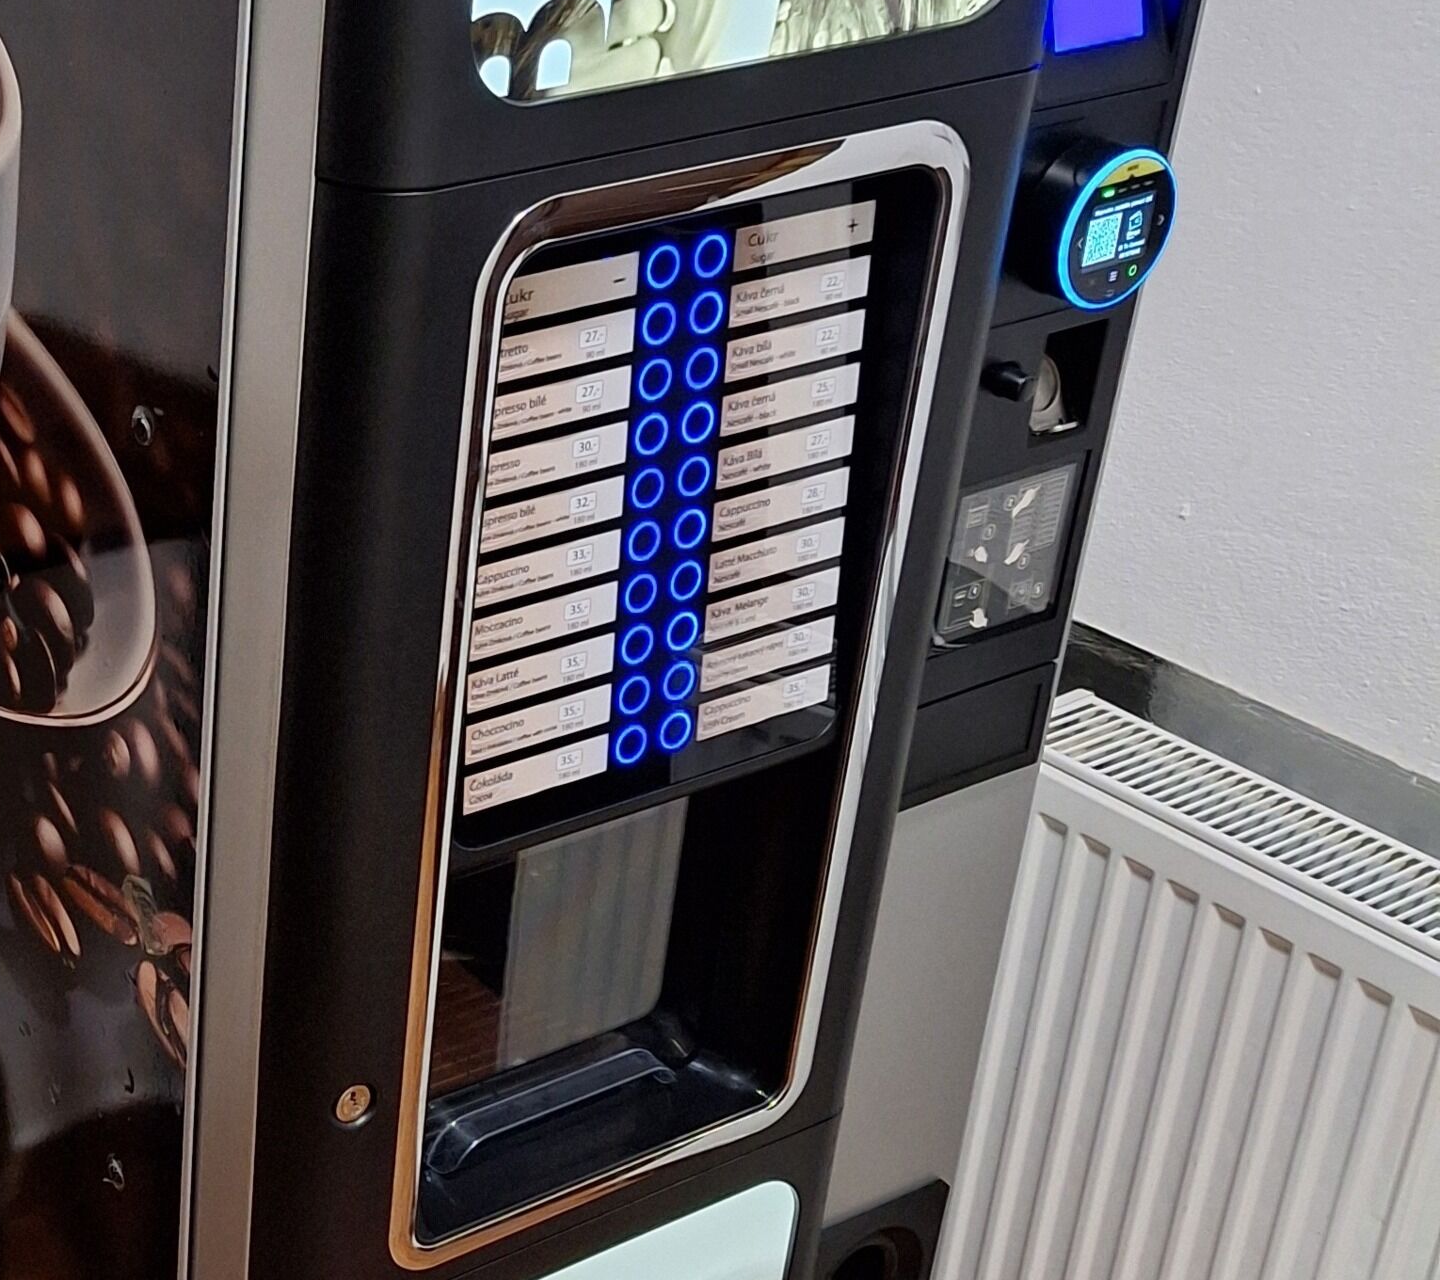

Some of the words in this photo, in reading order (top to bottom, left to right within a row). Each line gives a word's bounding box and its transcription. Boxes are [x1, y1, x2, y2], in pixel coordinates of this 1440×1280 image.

[748, 232, 778, 247] Cukr
[488, 459, 520, 476] presso
[476, 564, 530, 586] Cappuccino
